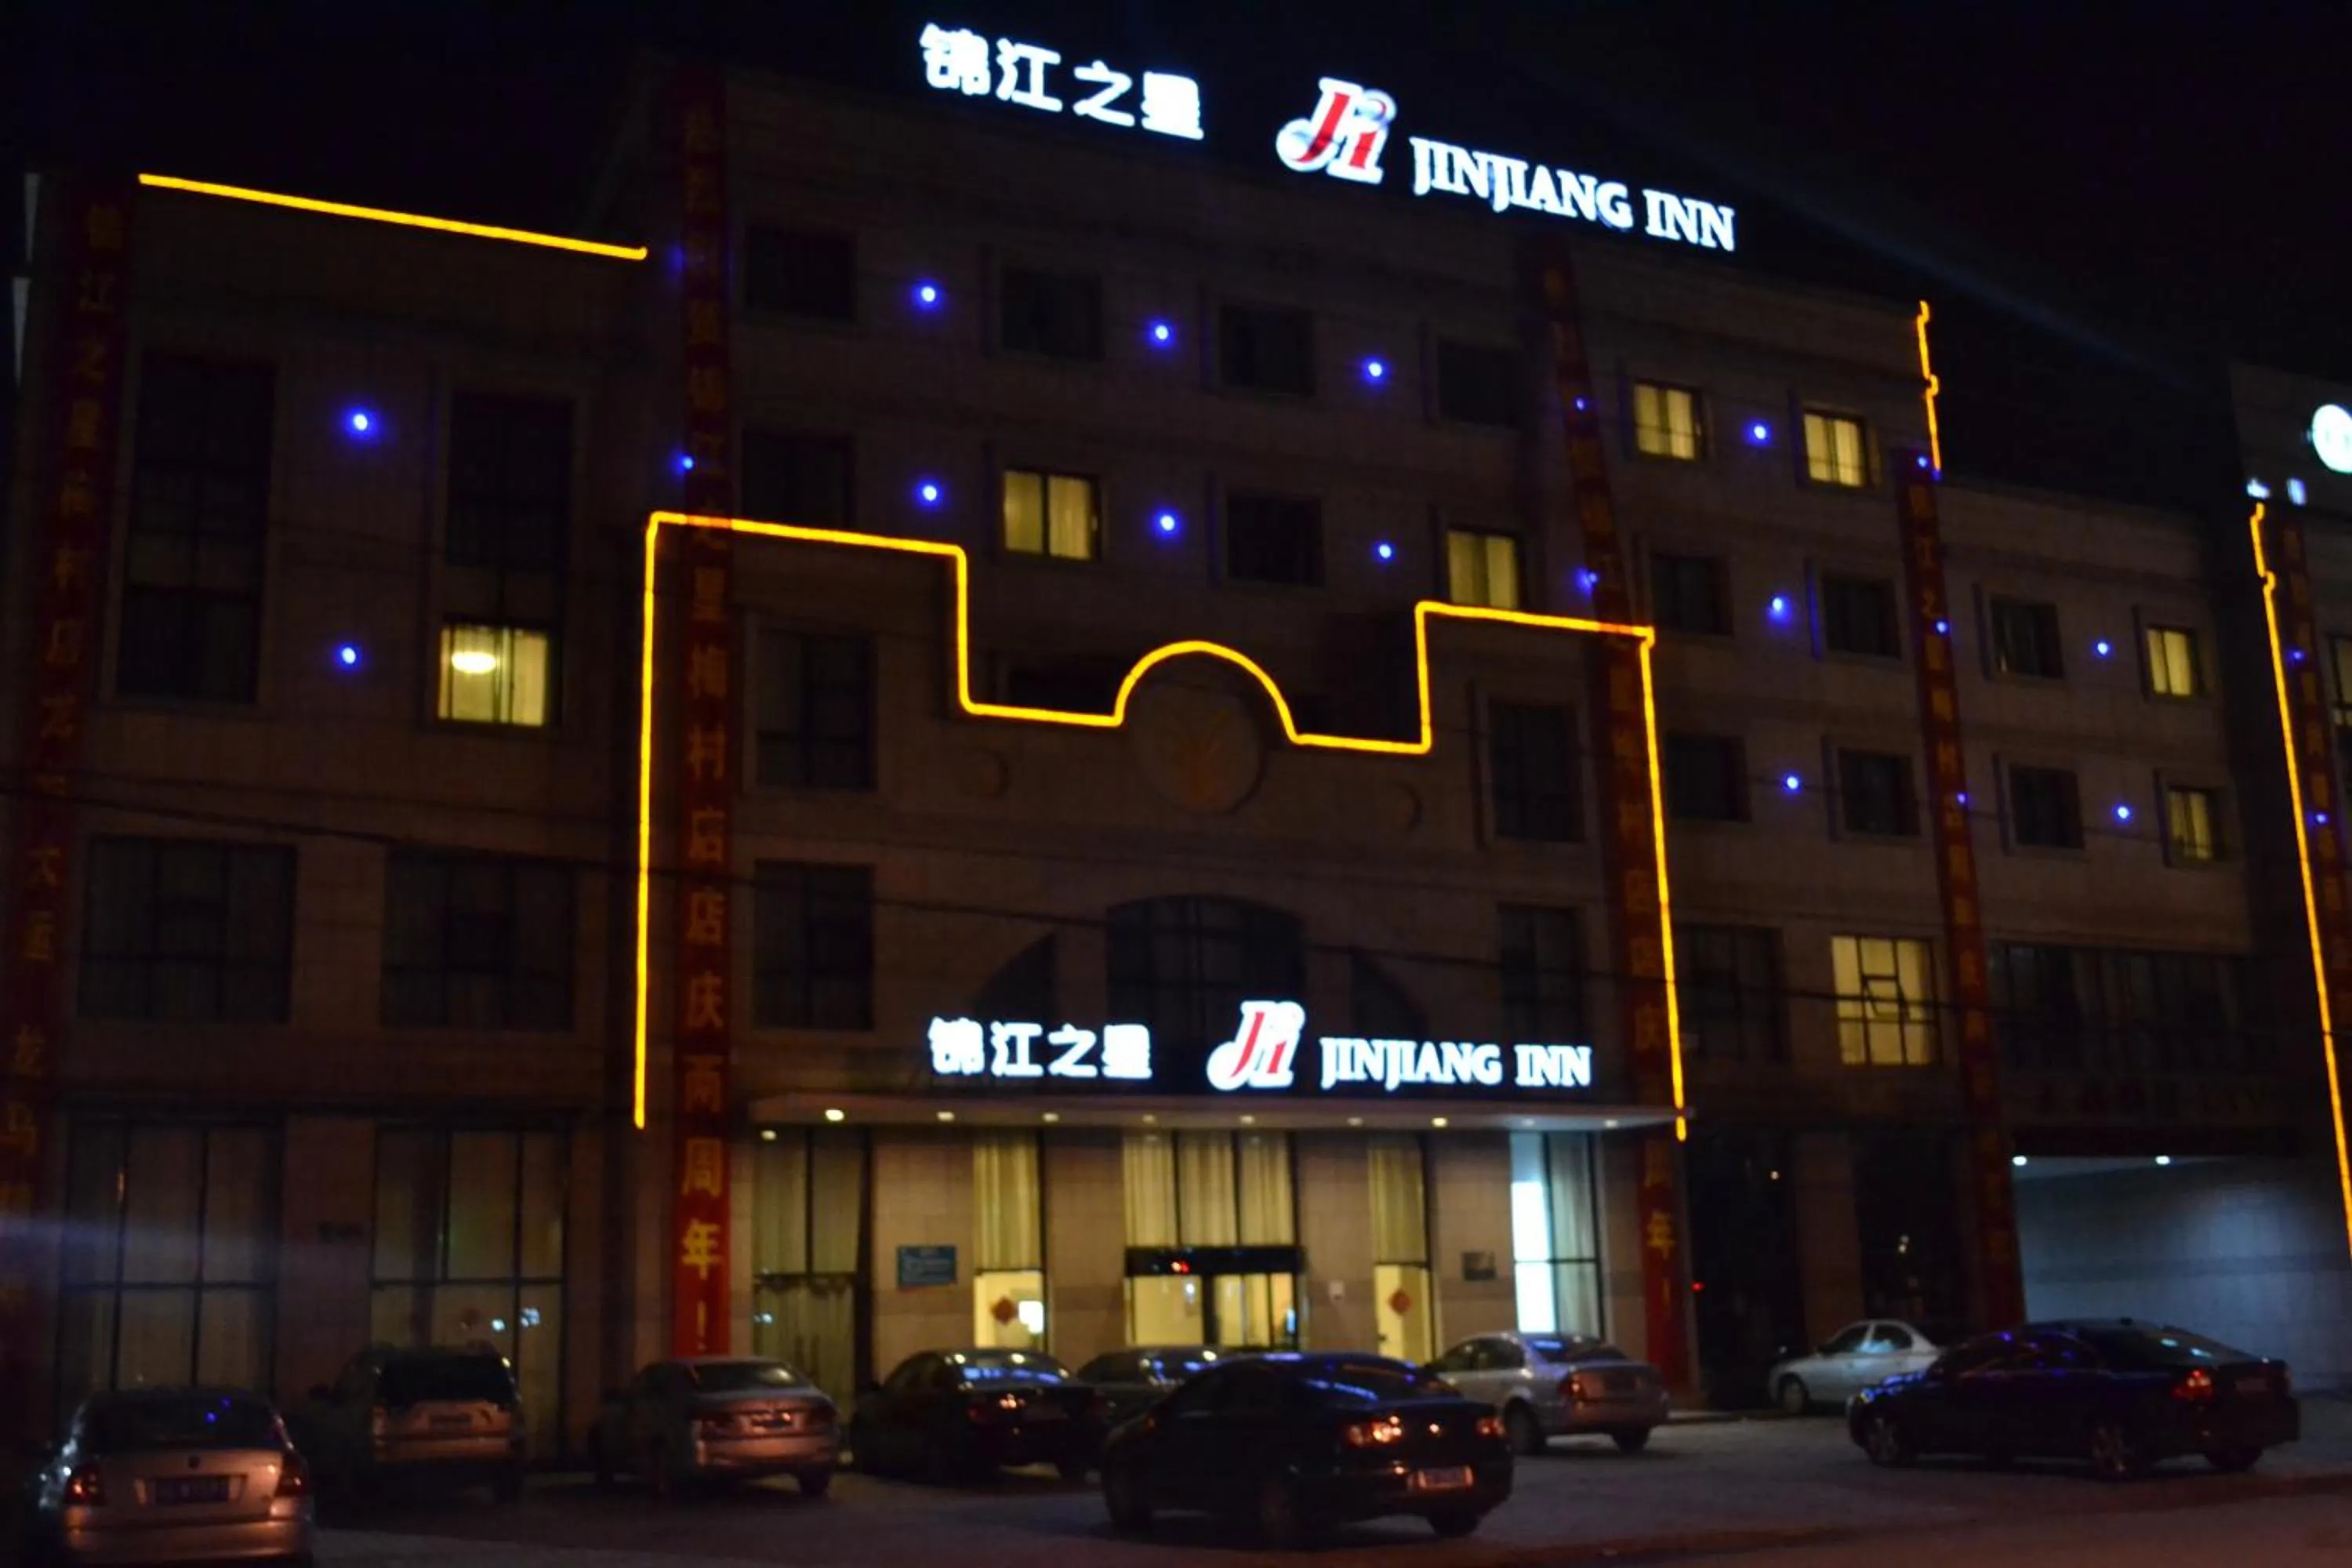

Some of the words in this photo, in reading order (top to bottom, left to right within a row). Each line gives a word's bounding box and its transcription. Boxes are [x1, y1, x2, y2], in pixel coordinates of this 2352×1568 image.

[920, 24, 1203, 140] 锦江之星
[1410, 136, 1634, 230] JINJIANG
[1642, 189, 1735, 252] INN
[1319, 1037, 1503, 1091] JINJIANG
[1514, 1044, 1592, 1087] INN
